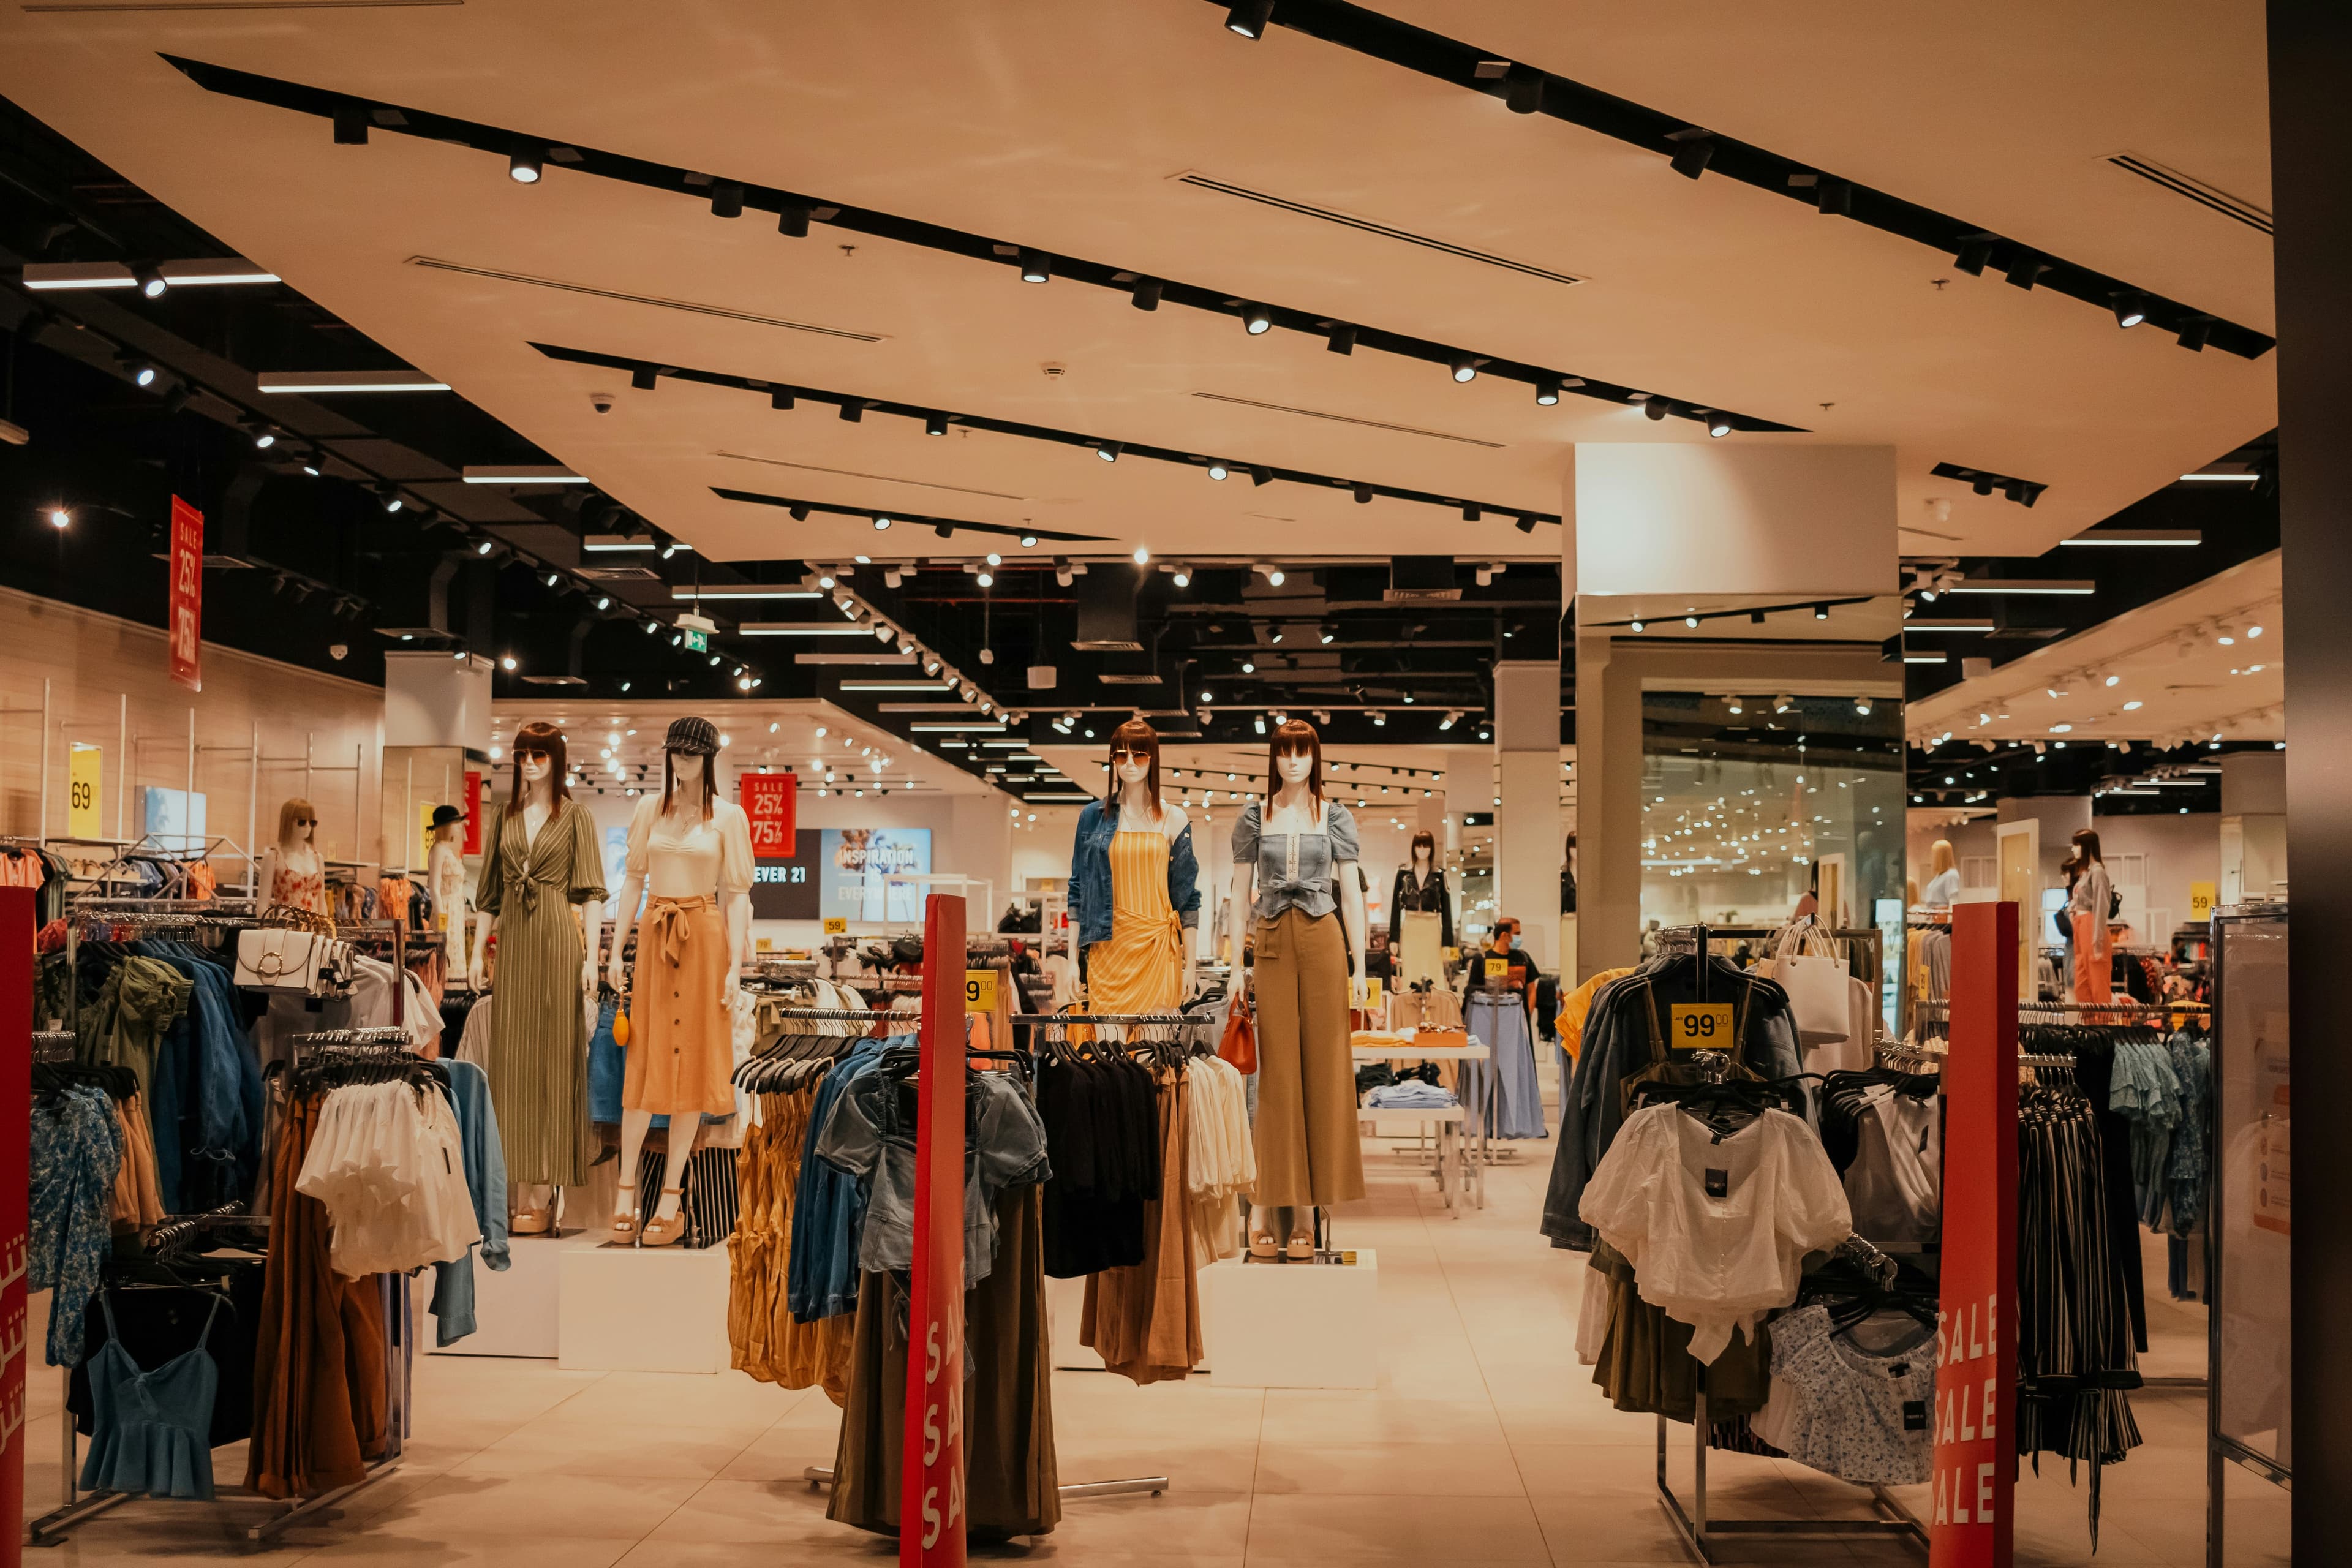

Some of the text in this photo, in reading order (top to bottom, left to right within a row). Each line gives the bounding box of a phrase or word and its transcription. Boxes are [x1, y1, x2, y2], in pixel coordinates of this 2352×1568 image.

[180, 522, 197, 549] SALE
[179, 549, 195, 598] 25%
[72, 782, 91, 810] 69
[755, 782, 783, 792] SALE
[754, 794, 783, 815] 25%
[753, 821, 783, 843] 75%
[839, 850, 913, 865] INSPIRATION
[754, 866, 806, 883] EVER 21
[2193, 897, 2207, 909] 59
[829, 921, 840, 930] 59
[1490, 963, 1501, 971] 79
[981, 981, 992, 991] 00
[1684, 1014, 1715, 1037] 99
[1716, 1014, 1728, 1025] 00
[1936, 1292, 1996, 1369] SALE
[924, 1381, 962, 1467] SA
[1933, 1462, 1994, 1526] ALE
